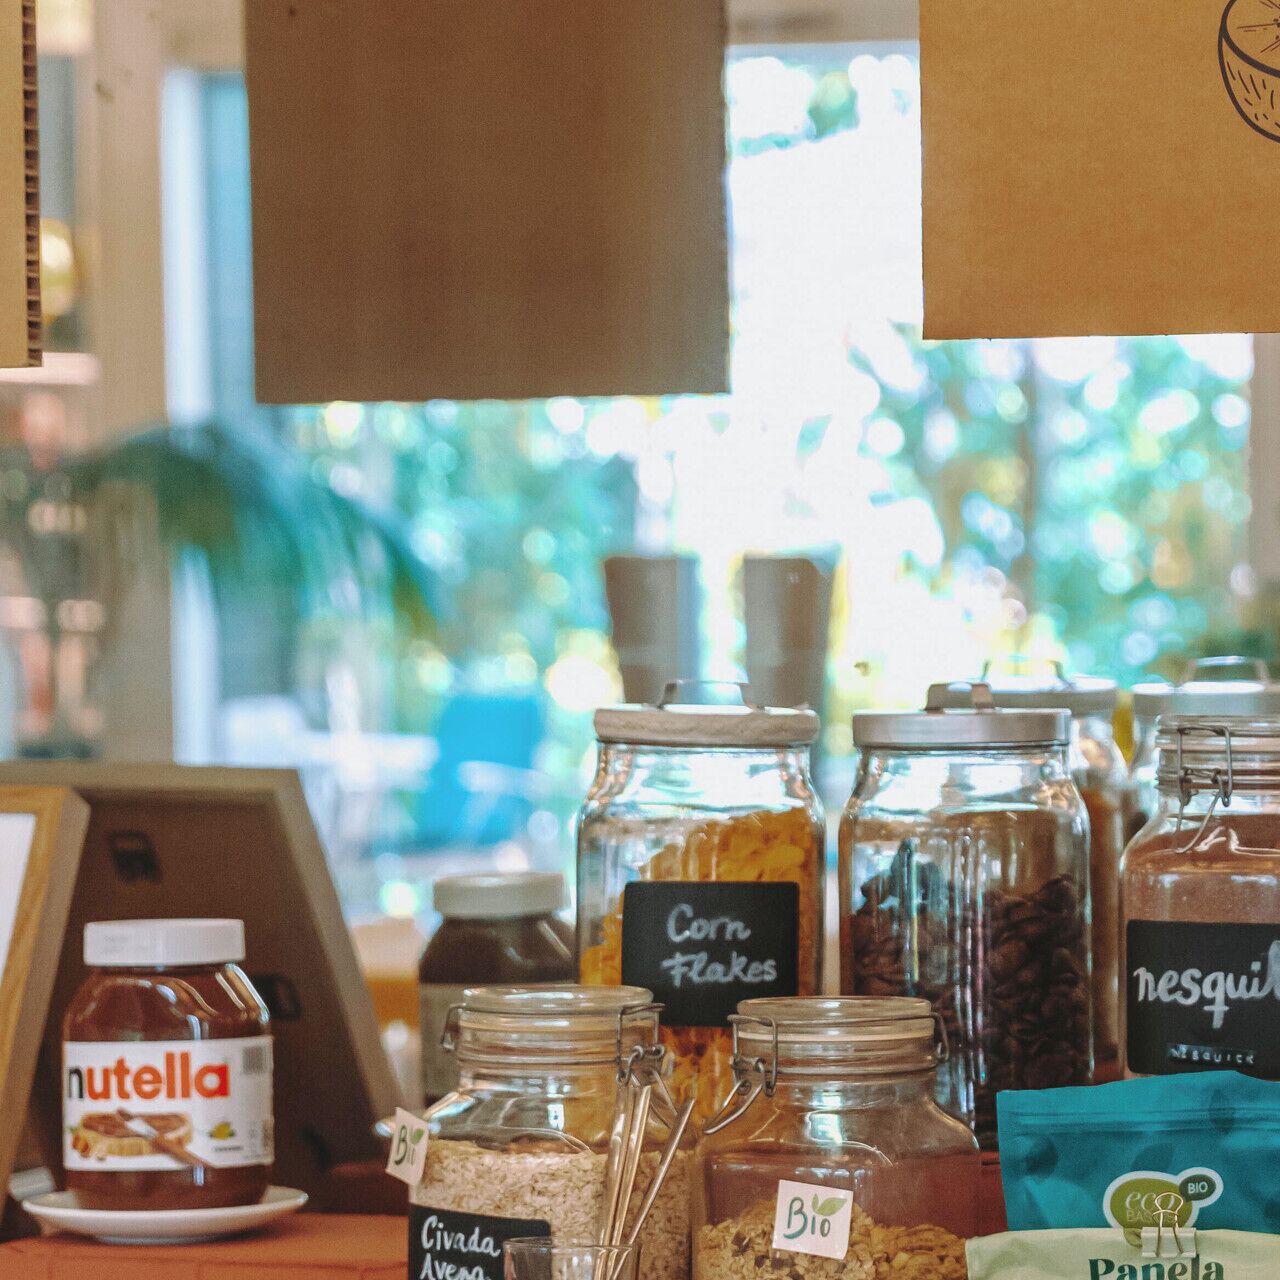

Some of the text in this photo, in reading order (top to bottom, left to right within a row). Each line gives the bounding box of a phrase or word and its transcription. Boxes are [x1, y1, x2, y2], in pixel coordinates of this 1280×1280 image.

[667, 903, 751, 943] Corn
[661, 951, 777, 987] Flakes
[68, 1051, 229, 1100] nutella
[1187, 1181, 1208, 1194] BIO
[421, 1215, 501, 1257] Civada
[783, 1197, 831, 1239] Bio
